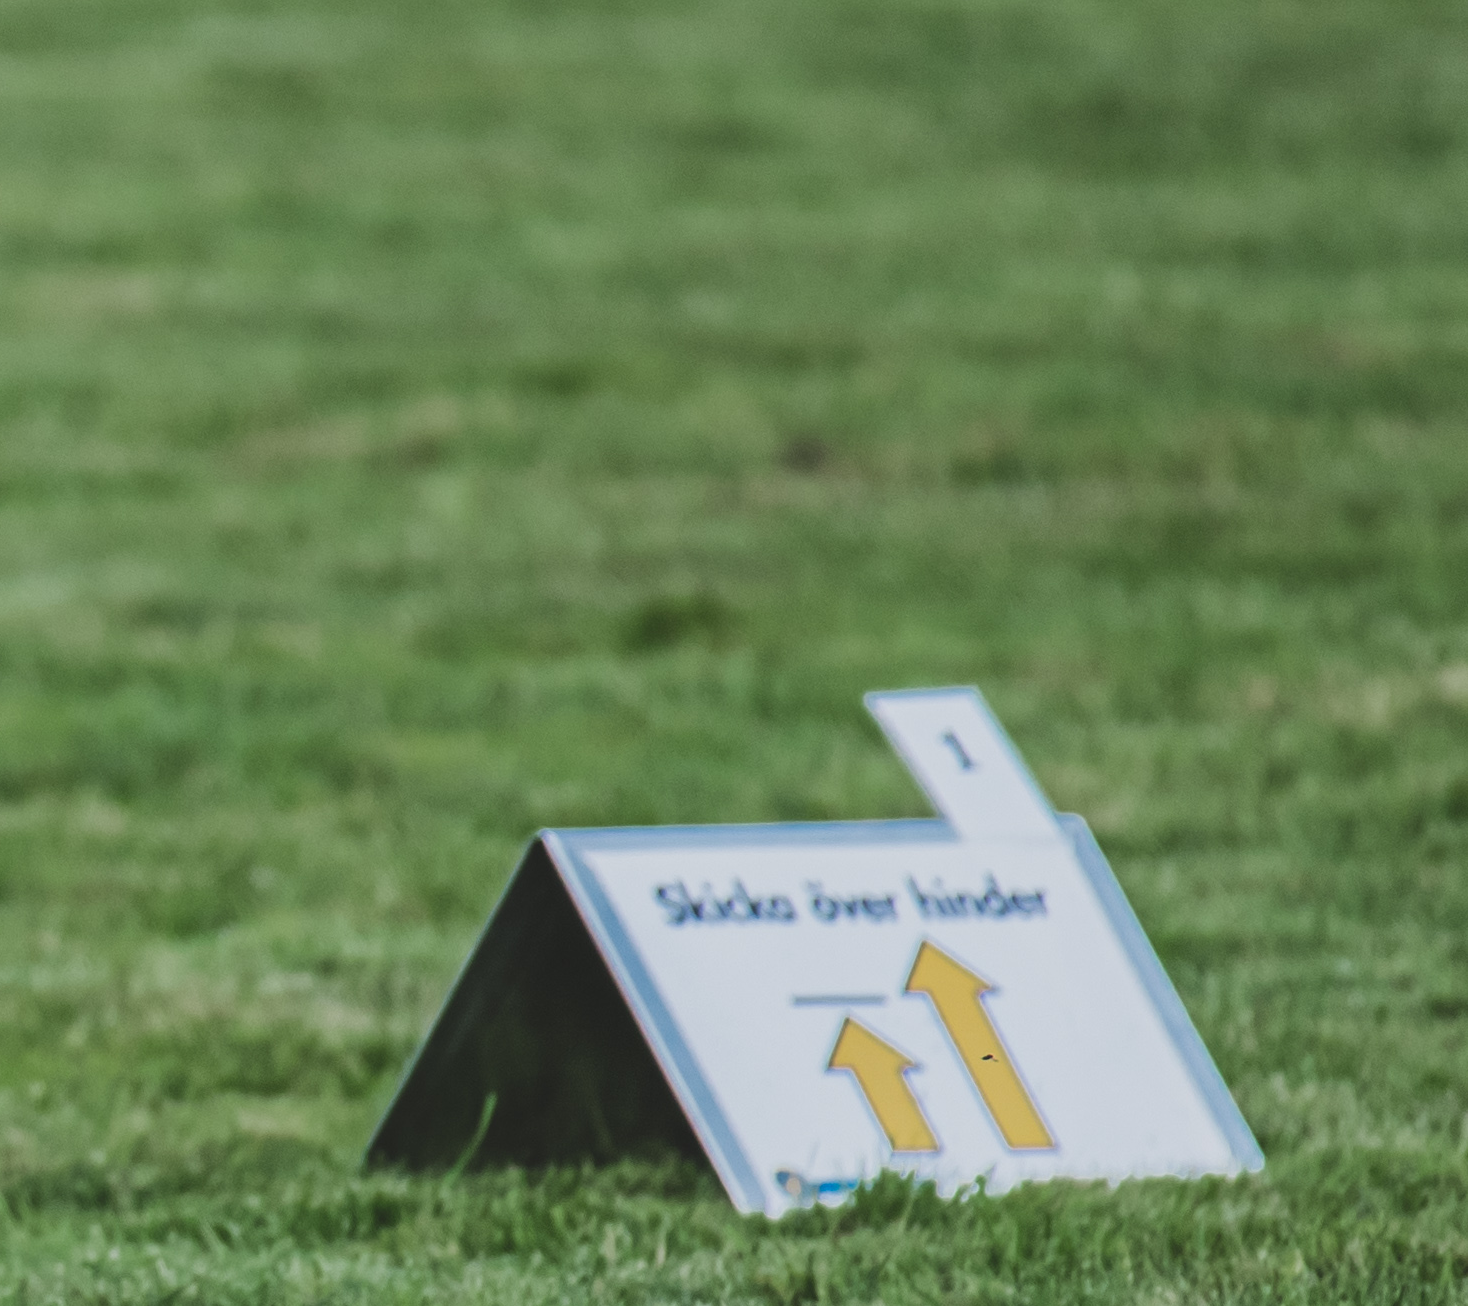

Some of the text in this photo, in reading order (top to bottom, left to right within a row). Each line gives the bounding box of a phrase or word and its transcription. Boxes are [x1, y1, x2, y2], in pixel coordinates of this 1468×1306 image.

[940, 729, 976, 773] 1
[654, 873, 1048, 926] Skicka över hinder
